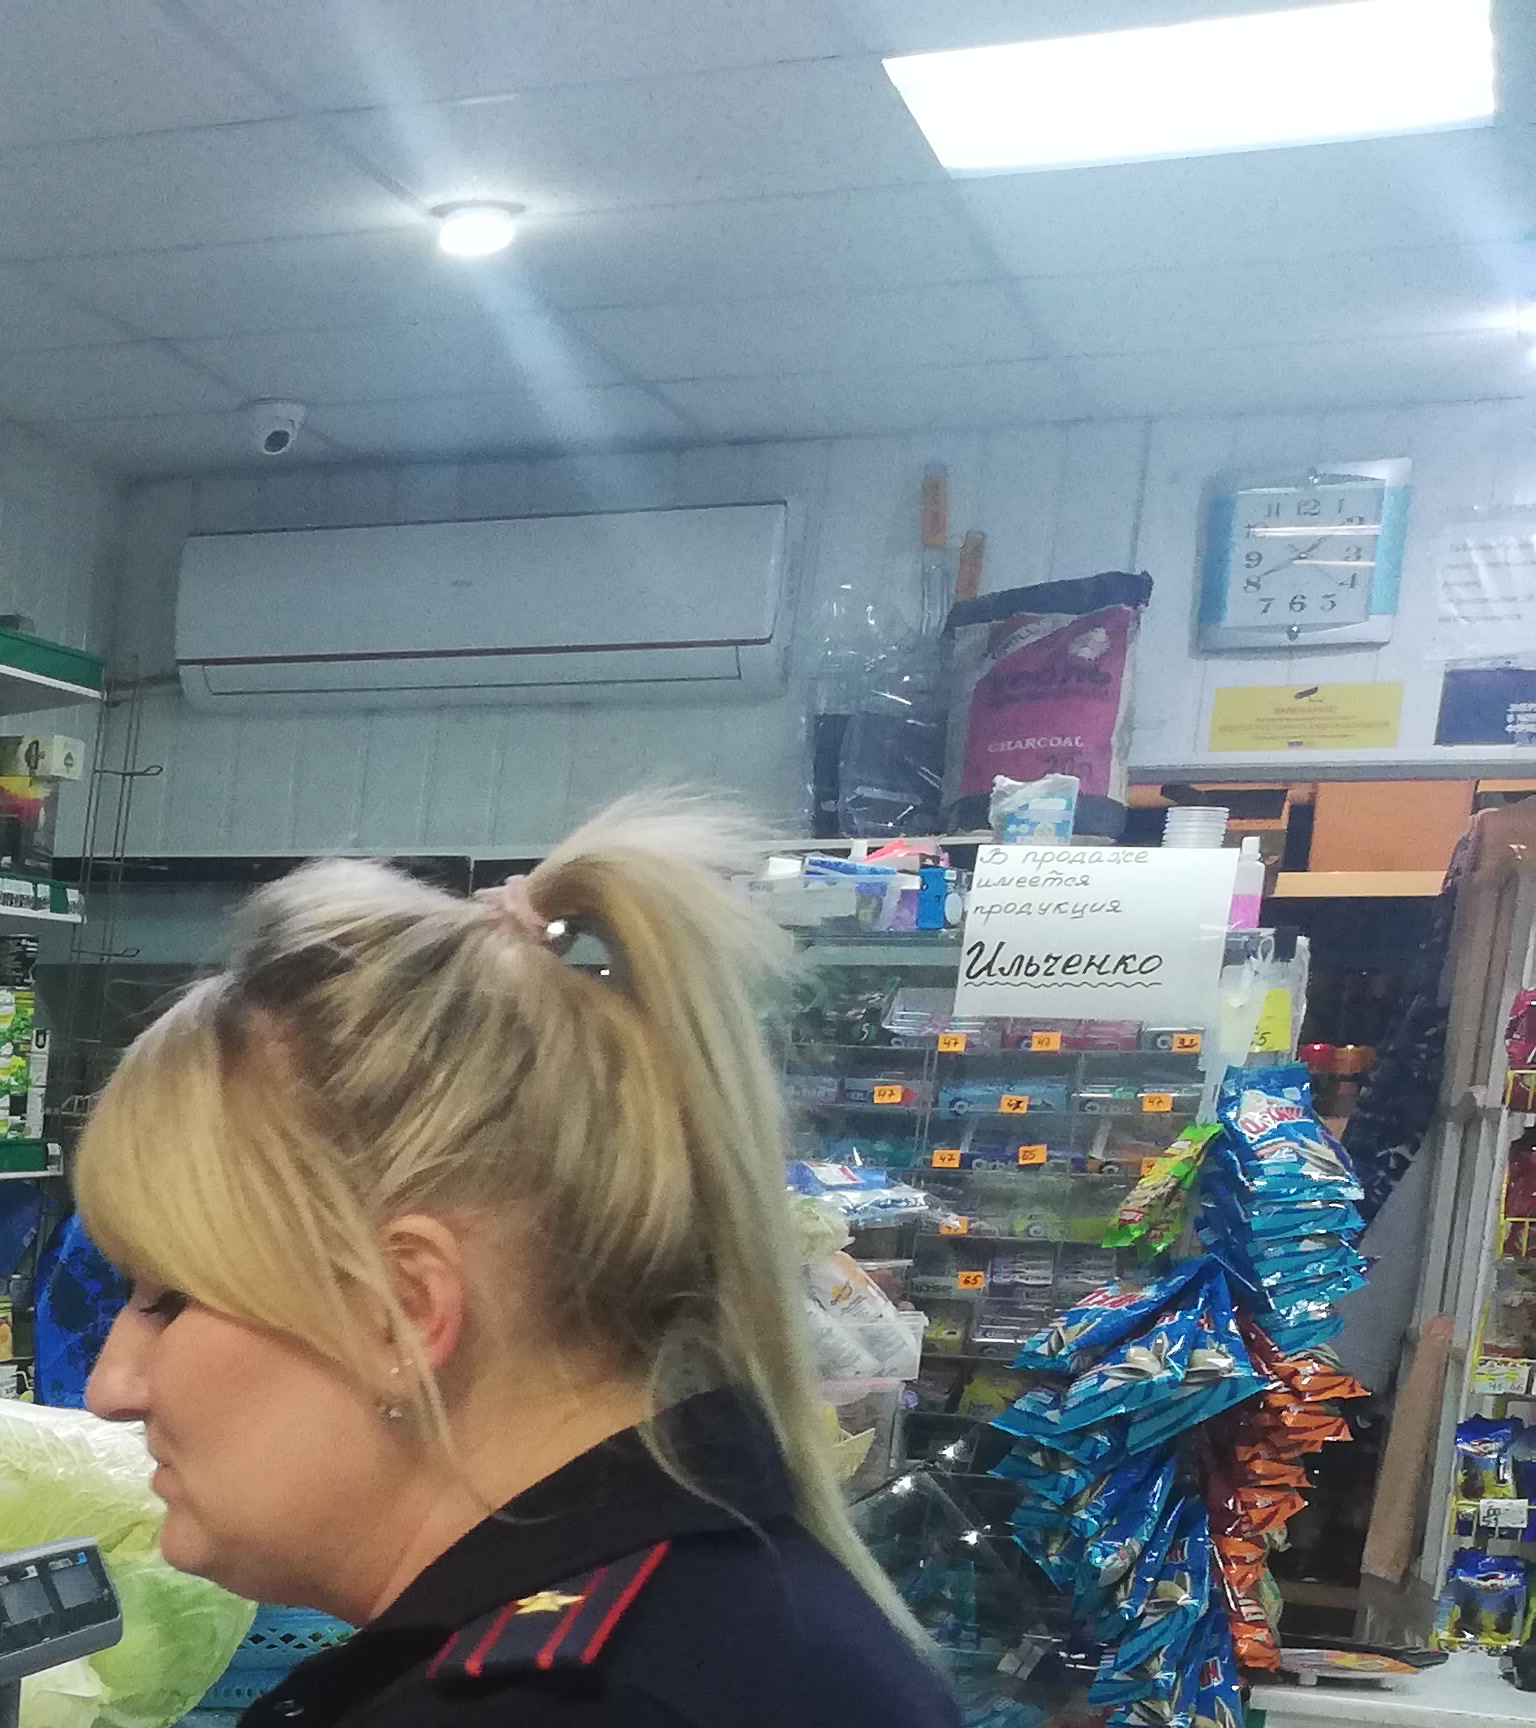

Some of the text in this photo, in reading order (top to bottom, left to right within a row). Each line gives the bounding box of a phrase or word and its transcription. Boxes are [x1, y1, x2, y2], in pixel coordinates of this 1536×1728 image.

[1297, 499, 1321, 516] 12
[1244, 551, 1263, 569] 9
[1243, 575, 1262, 593] 8
[1338, 573, 1357, 589] 4
[1258, 597, 1275, 614] 7
[1289, 595, 1307, 612] 6
[1320, 594, 1337, 611] 5
[987, 735, 1085, 753] CHARCOAL
[979, 847, 1149, 871] В продаже
[976, 869, 1090, 888] имеется
[972, 899, 1123, 925] продукция
[965, 940, 1163, 980] Ильченко
